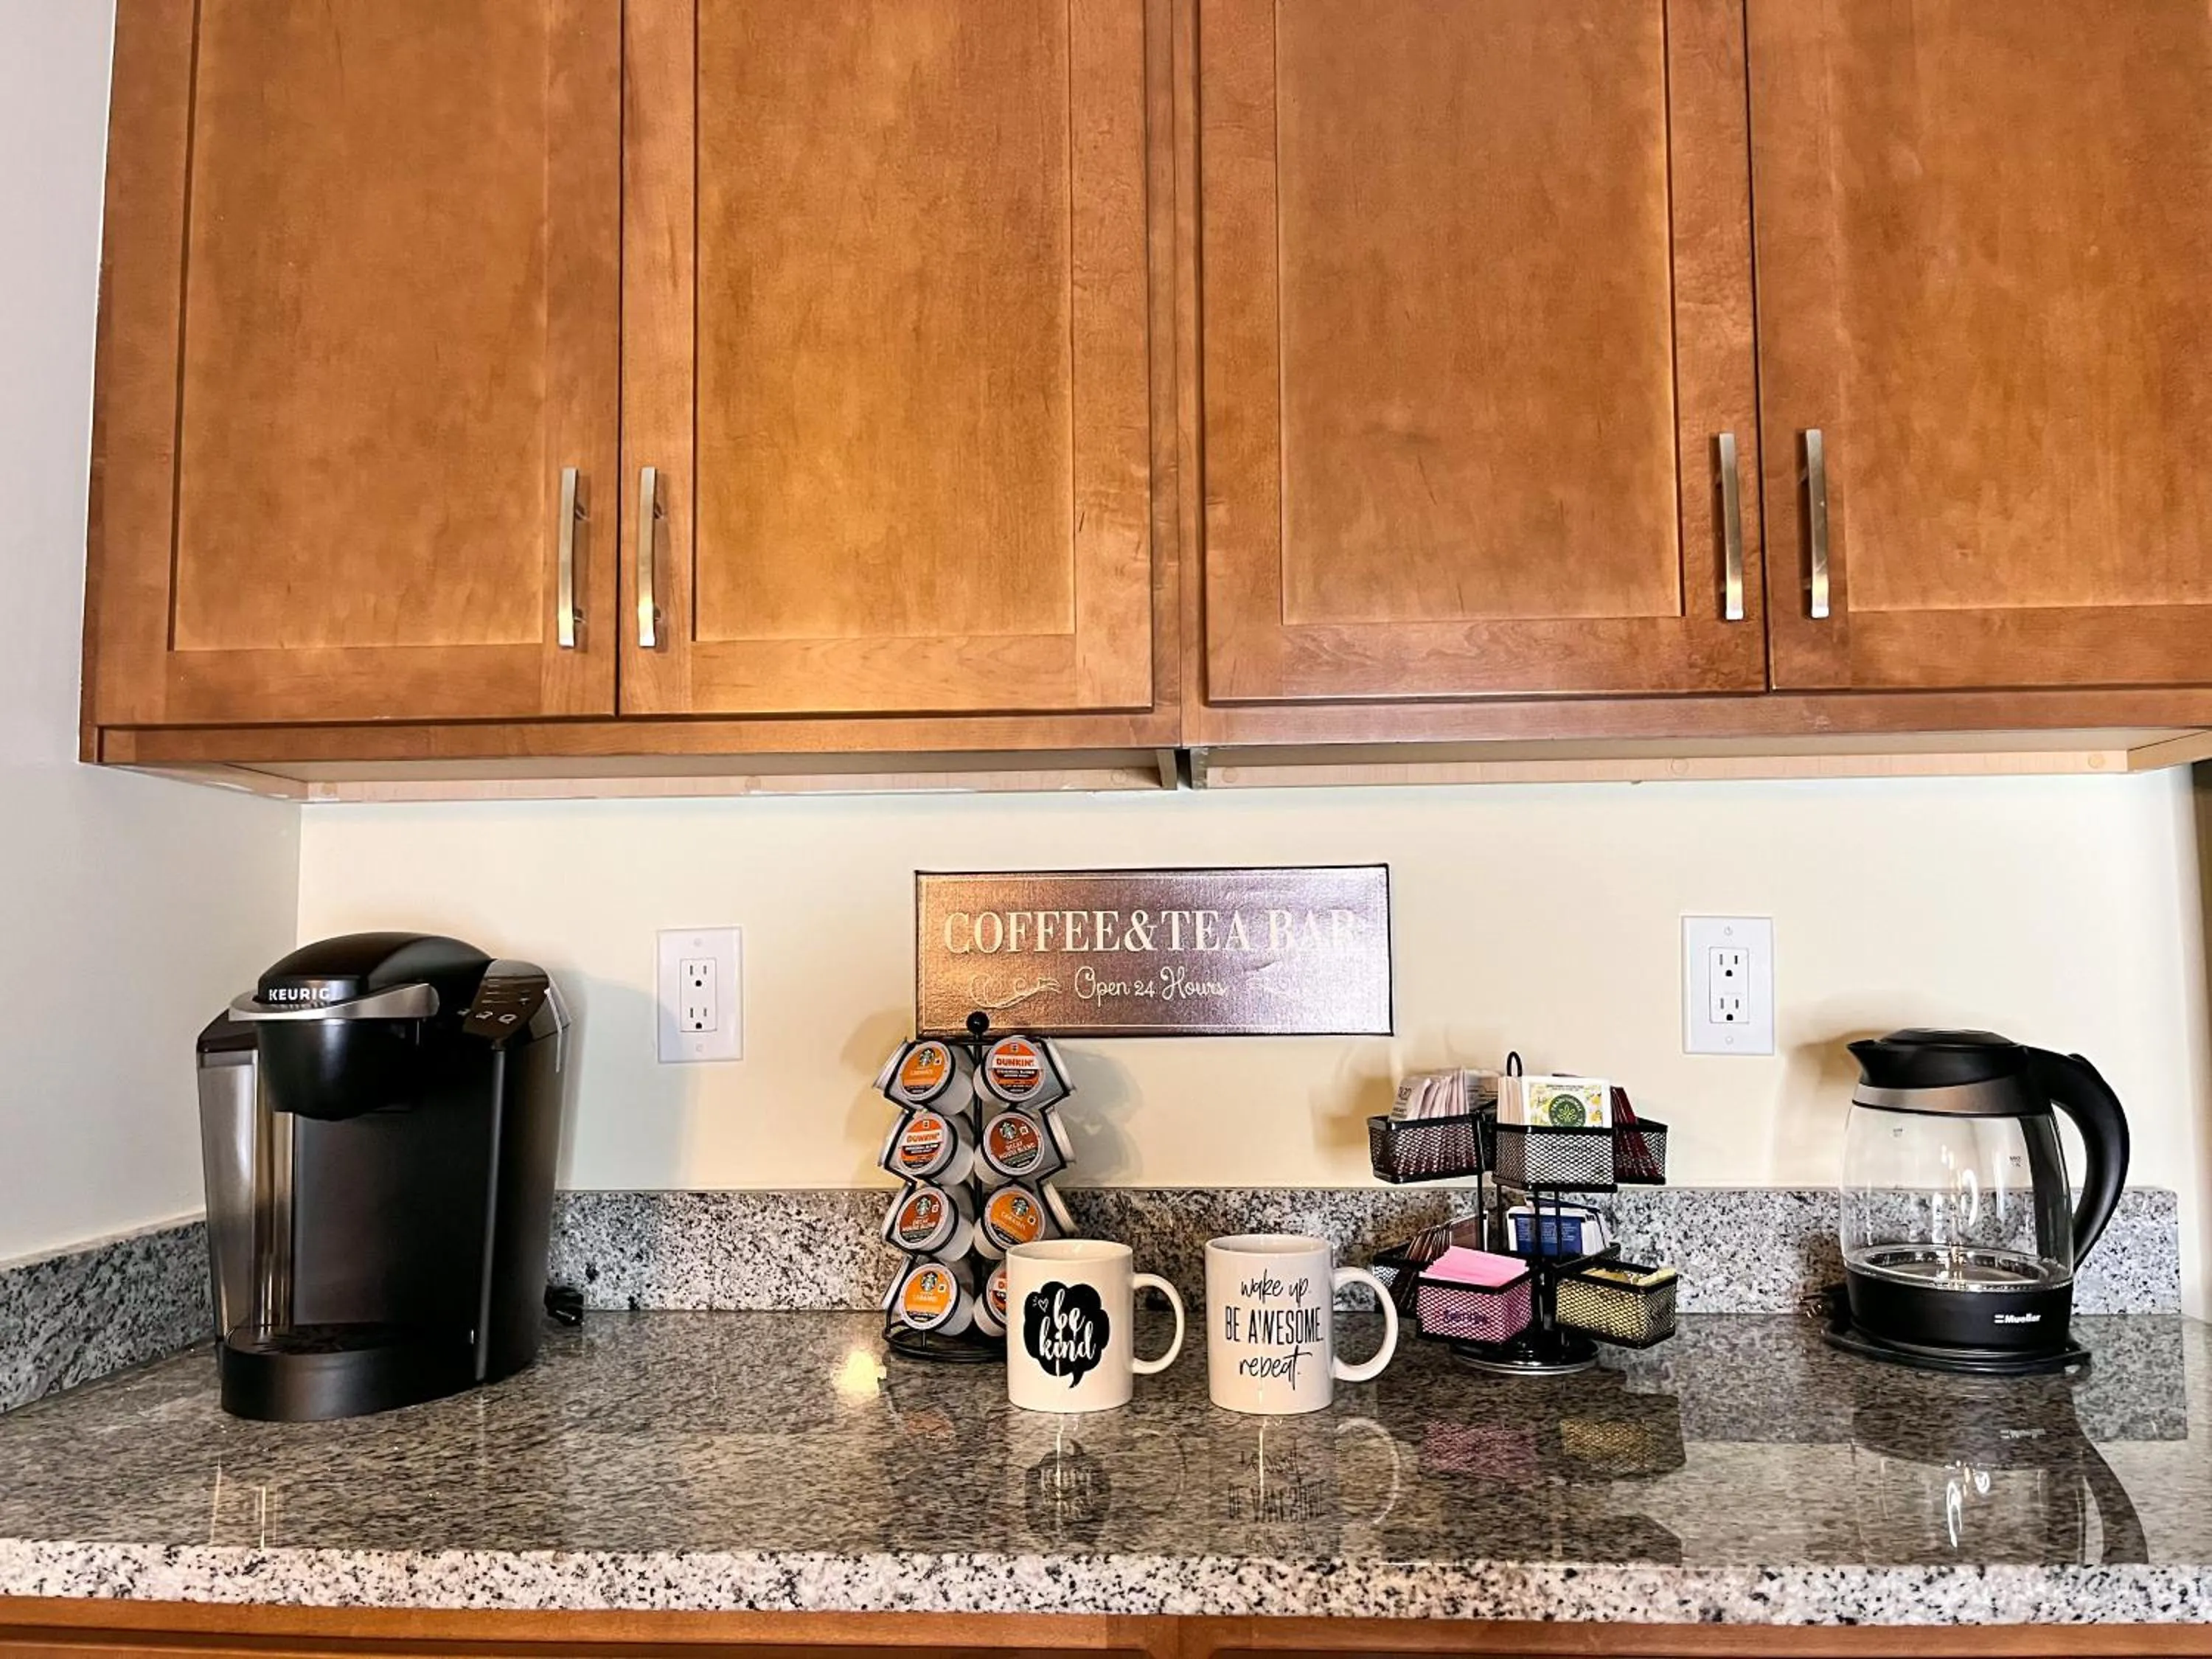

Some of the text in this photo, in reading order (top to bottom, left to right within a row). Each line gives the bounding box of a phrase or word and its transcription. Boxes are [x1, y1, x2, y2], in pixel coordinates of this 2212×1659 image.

[944, 909, 1363, 953] COFFEE&TEA BAR
[268, 987, 330, 1001] KEURIG
[1074, 966, 1227, 1007] Open 24 Hours
[1241, 1268, 1284, 1304] wake
[1053, 1288, 1085, 1341] be
[1225, 1306, 1241, 1342] BE
[1039, 1317, 1097, 1362] kind
